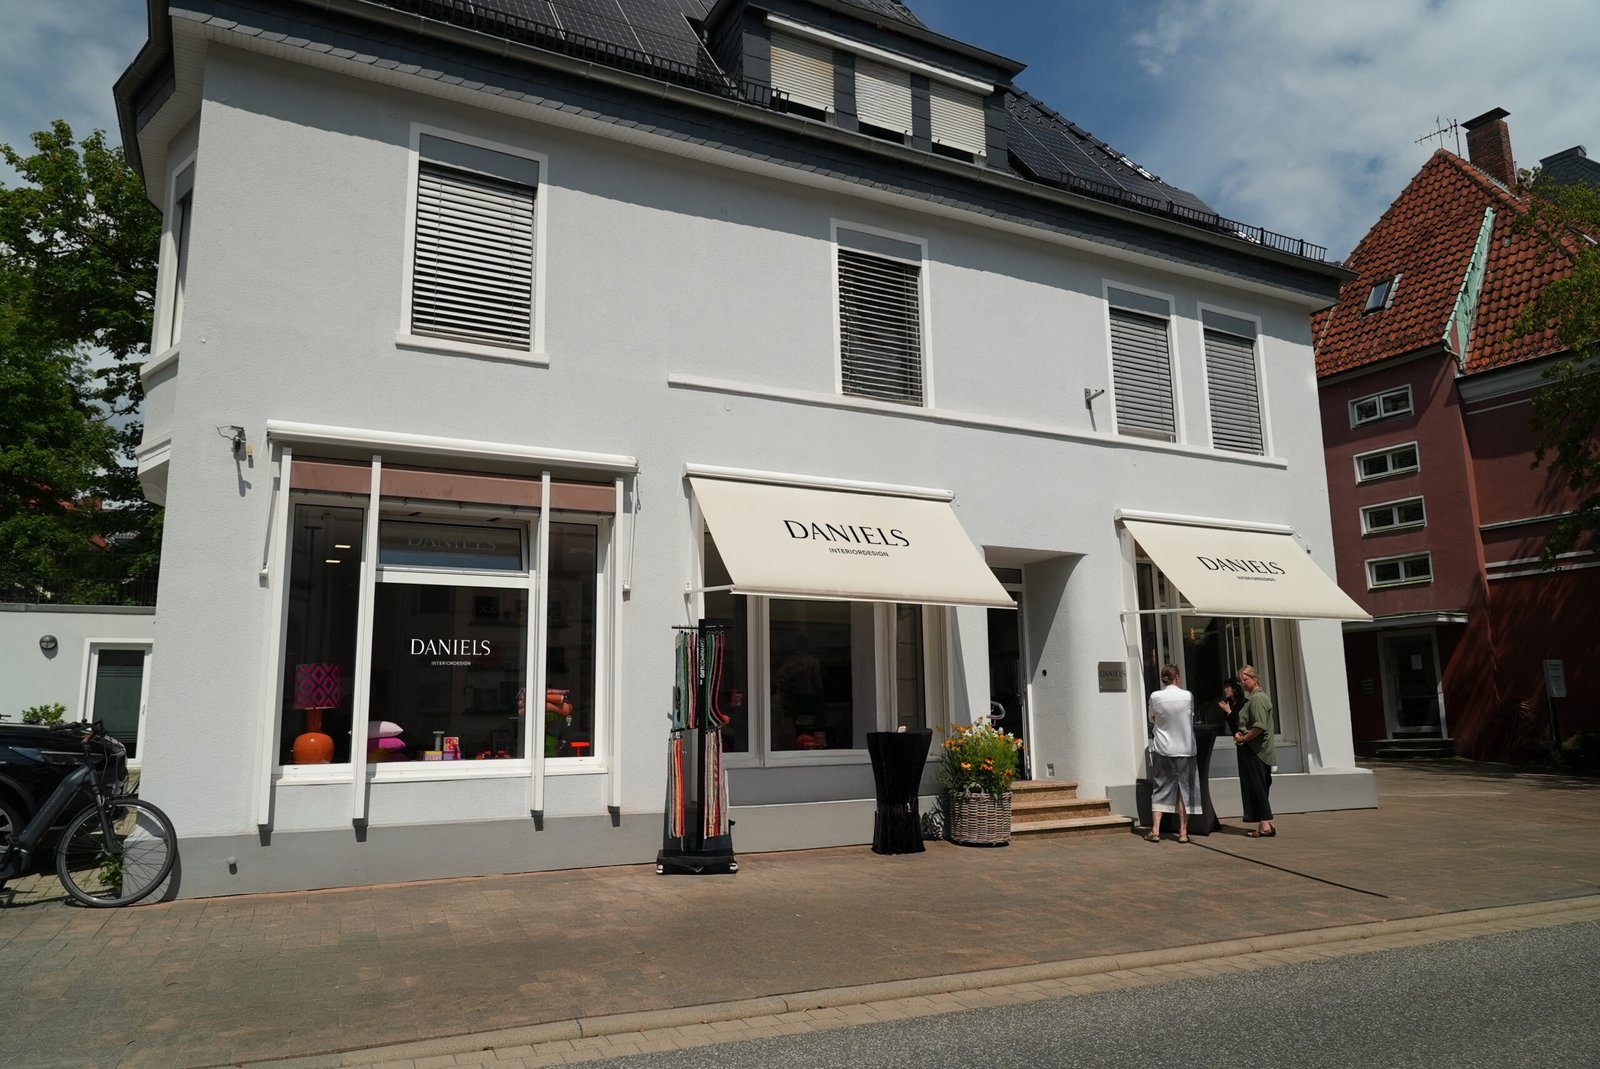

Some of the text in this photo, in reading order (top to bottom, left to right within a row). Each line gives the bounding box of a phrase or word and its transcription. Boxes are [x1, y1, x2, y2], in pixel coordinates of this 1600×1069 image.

[783, 519, 910, 547] DANIELS
[828, 547, 889, 557] INTERIORDESIGN
[1196, 556, 1286, 575] DANIELS
[410, 638, 491, 656] DANIELS
